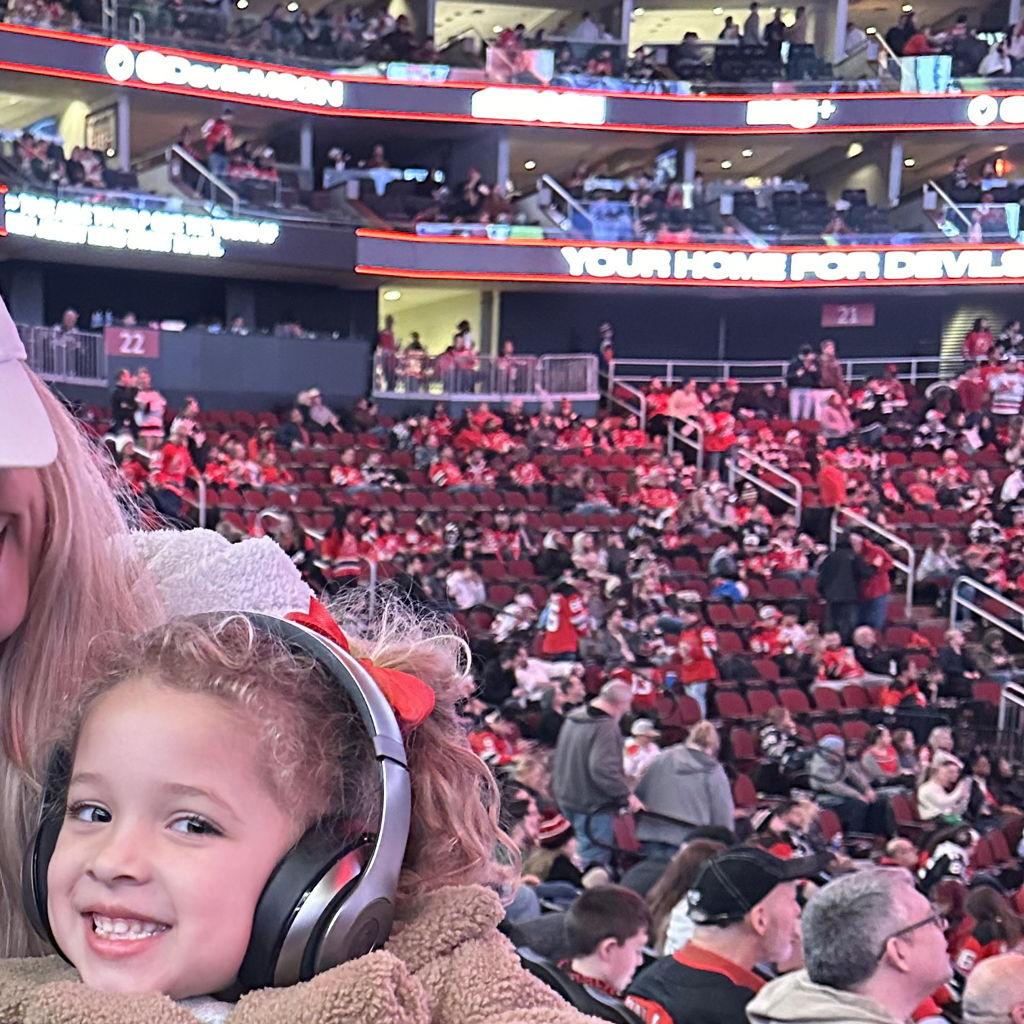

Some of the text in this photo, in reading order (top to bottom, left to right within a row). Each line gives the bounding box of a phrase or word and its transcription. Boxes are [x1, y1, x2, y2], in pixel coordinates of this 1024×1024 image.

[560, 247, 1024, 281] YOUR HOME FOR DEVILS
[837, 304, 857, 325] 21
[119, 331, 145, 354] 22
